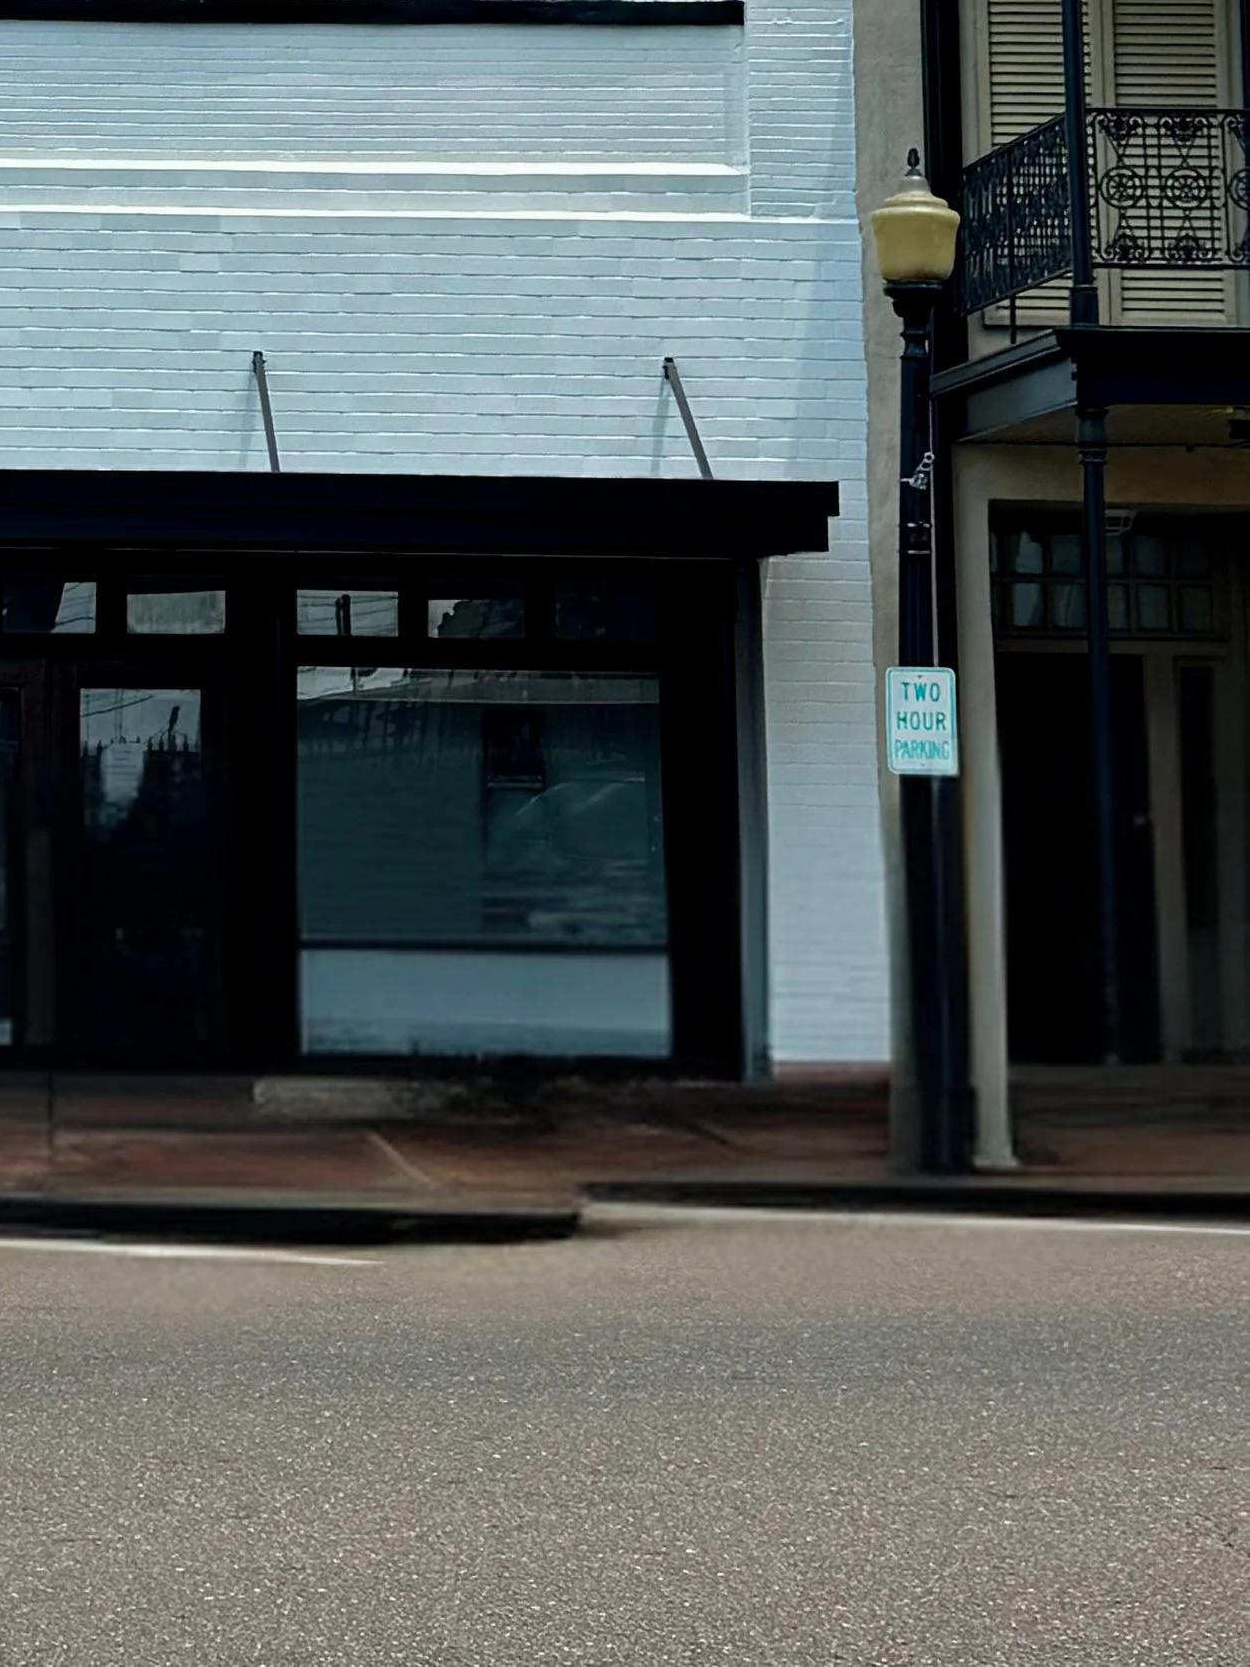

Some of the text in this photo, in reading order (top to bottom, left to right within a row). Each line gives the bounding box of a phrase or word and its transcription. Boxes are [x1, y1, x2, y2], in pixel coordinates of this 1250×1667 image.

[902, 682, 941, 702] TWO
[897, 711, 947, 731] HOUR
[894, 739, 950, 759] PARKING
